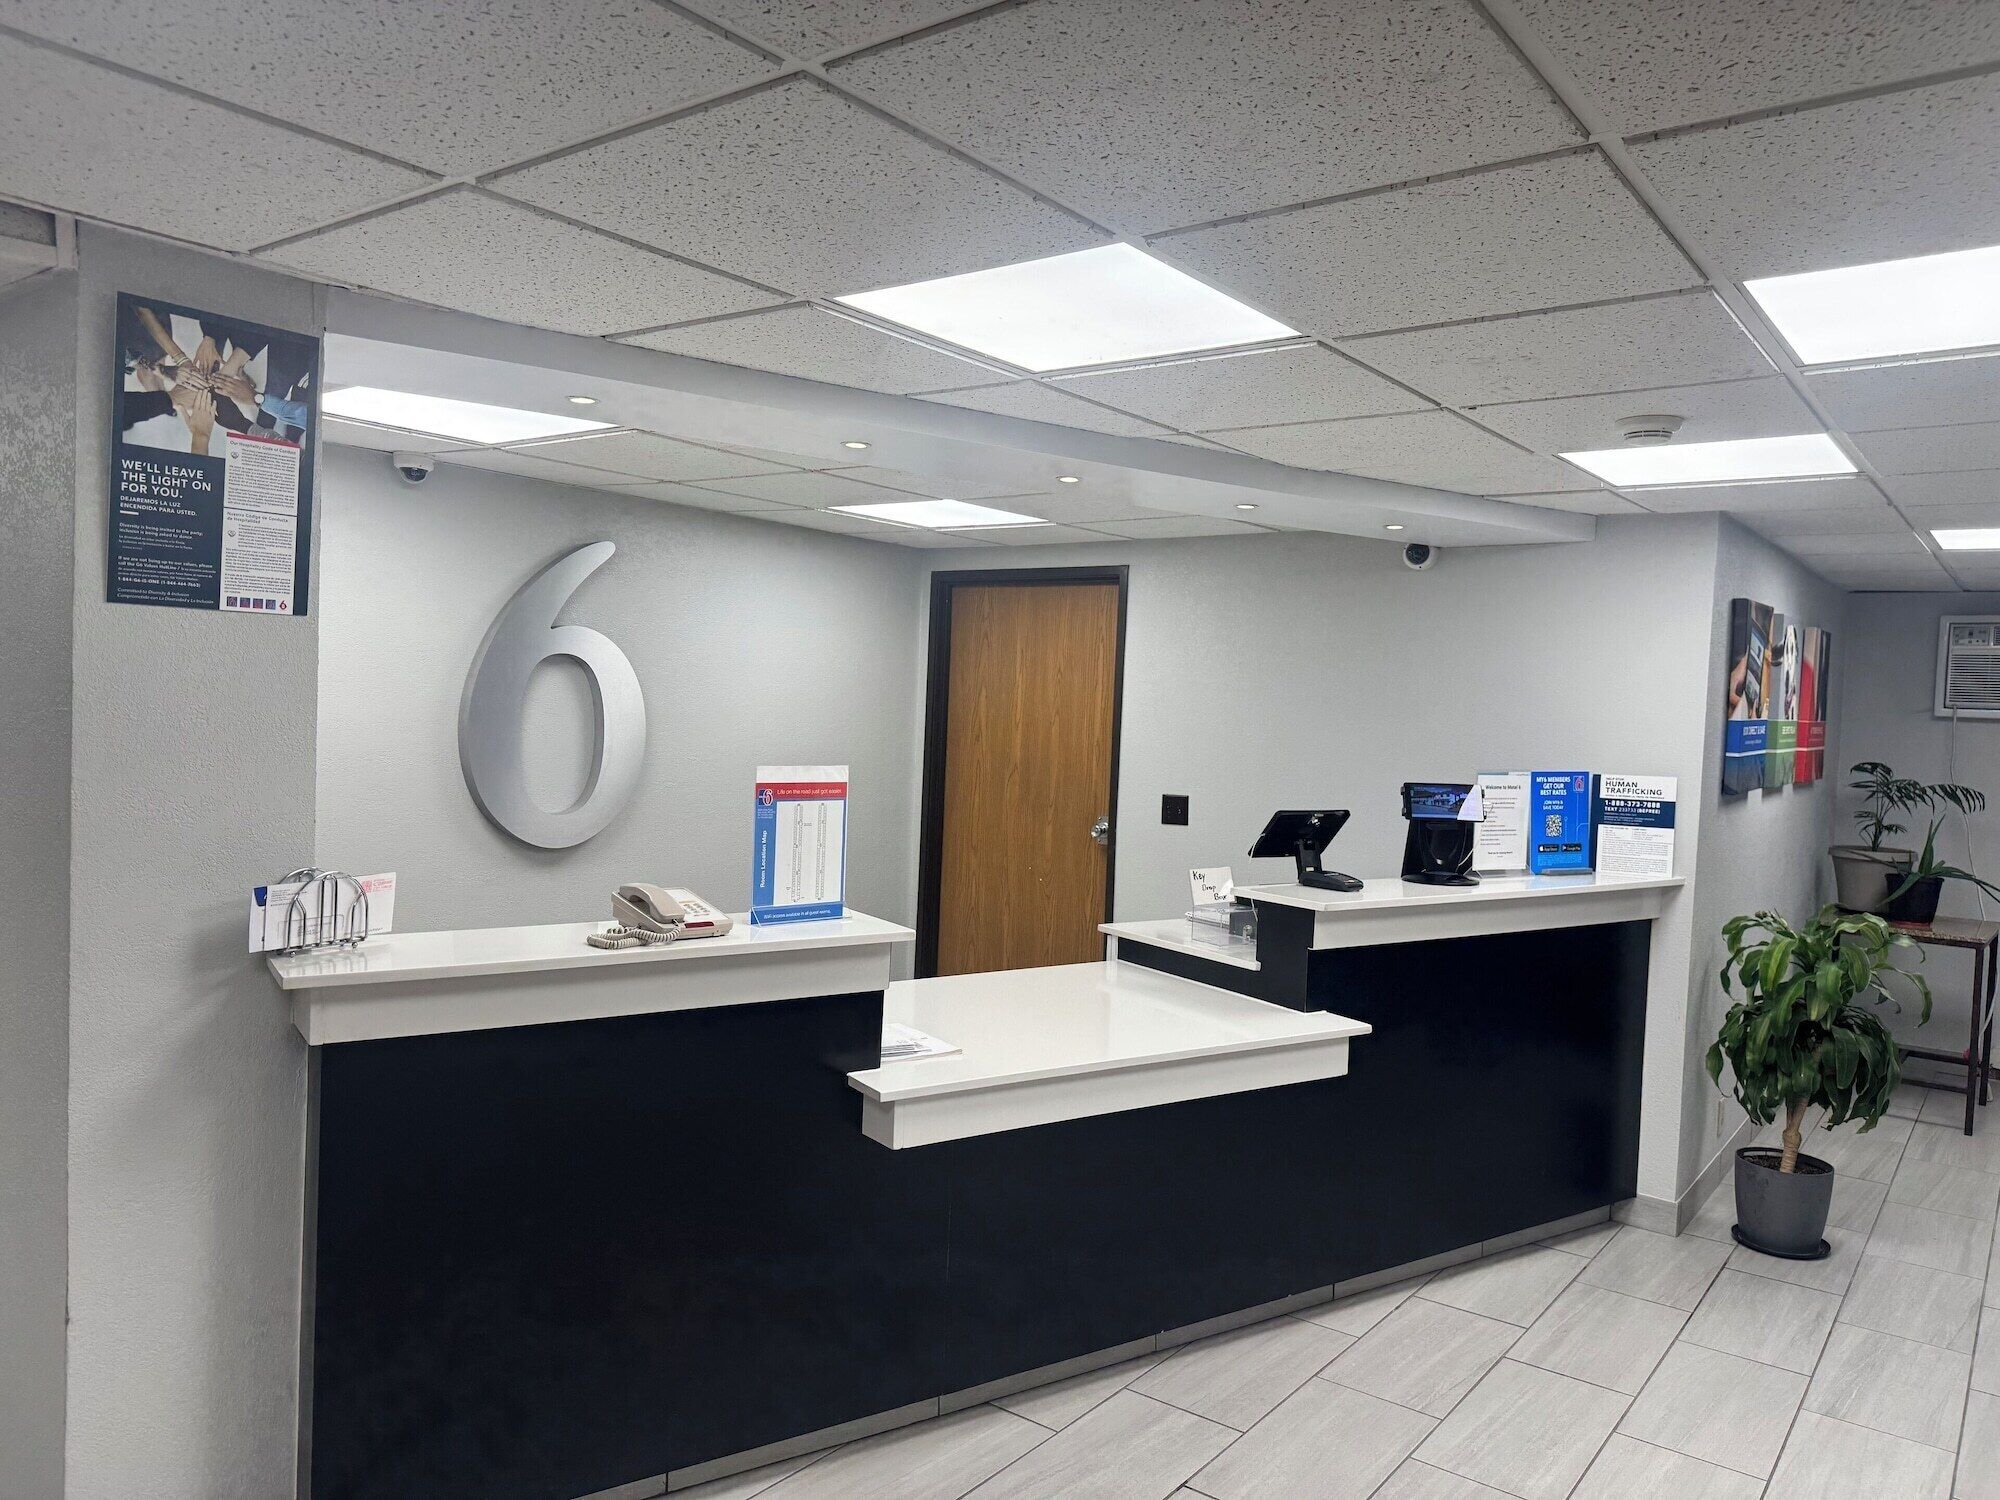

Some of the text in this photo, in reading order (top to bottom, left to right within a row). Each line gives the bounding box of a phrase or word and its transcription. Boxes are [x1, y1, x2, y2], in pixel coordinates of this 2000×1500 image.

[122, 459, 204, 480] WE'LL LEAVE
[121, 471, 212, 492] THE LIGHT ON
[121, 482, 183, 498] FOR YOU.
[120, 495, 158, 505] DEJAREMOS
[120, 502, 158, 512] ENCENDIDA
[458, 541, 646, 849] 6
[1606, 787, 1662, 796] TRAFFICKING
[1192, 870, 1206, 882] Key
[1202, 884, 1216, 892] Drop
[1214, 892, 1227, 900] Box
